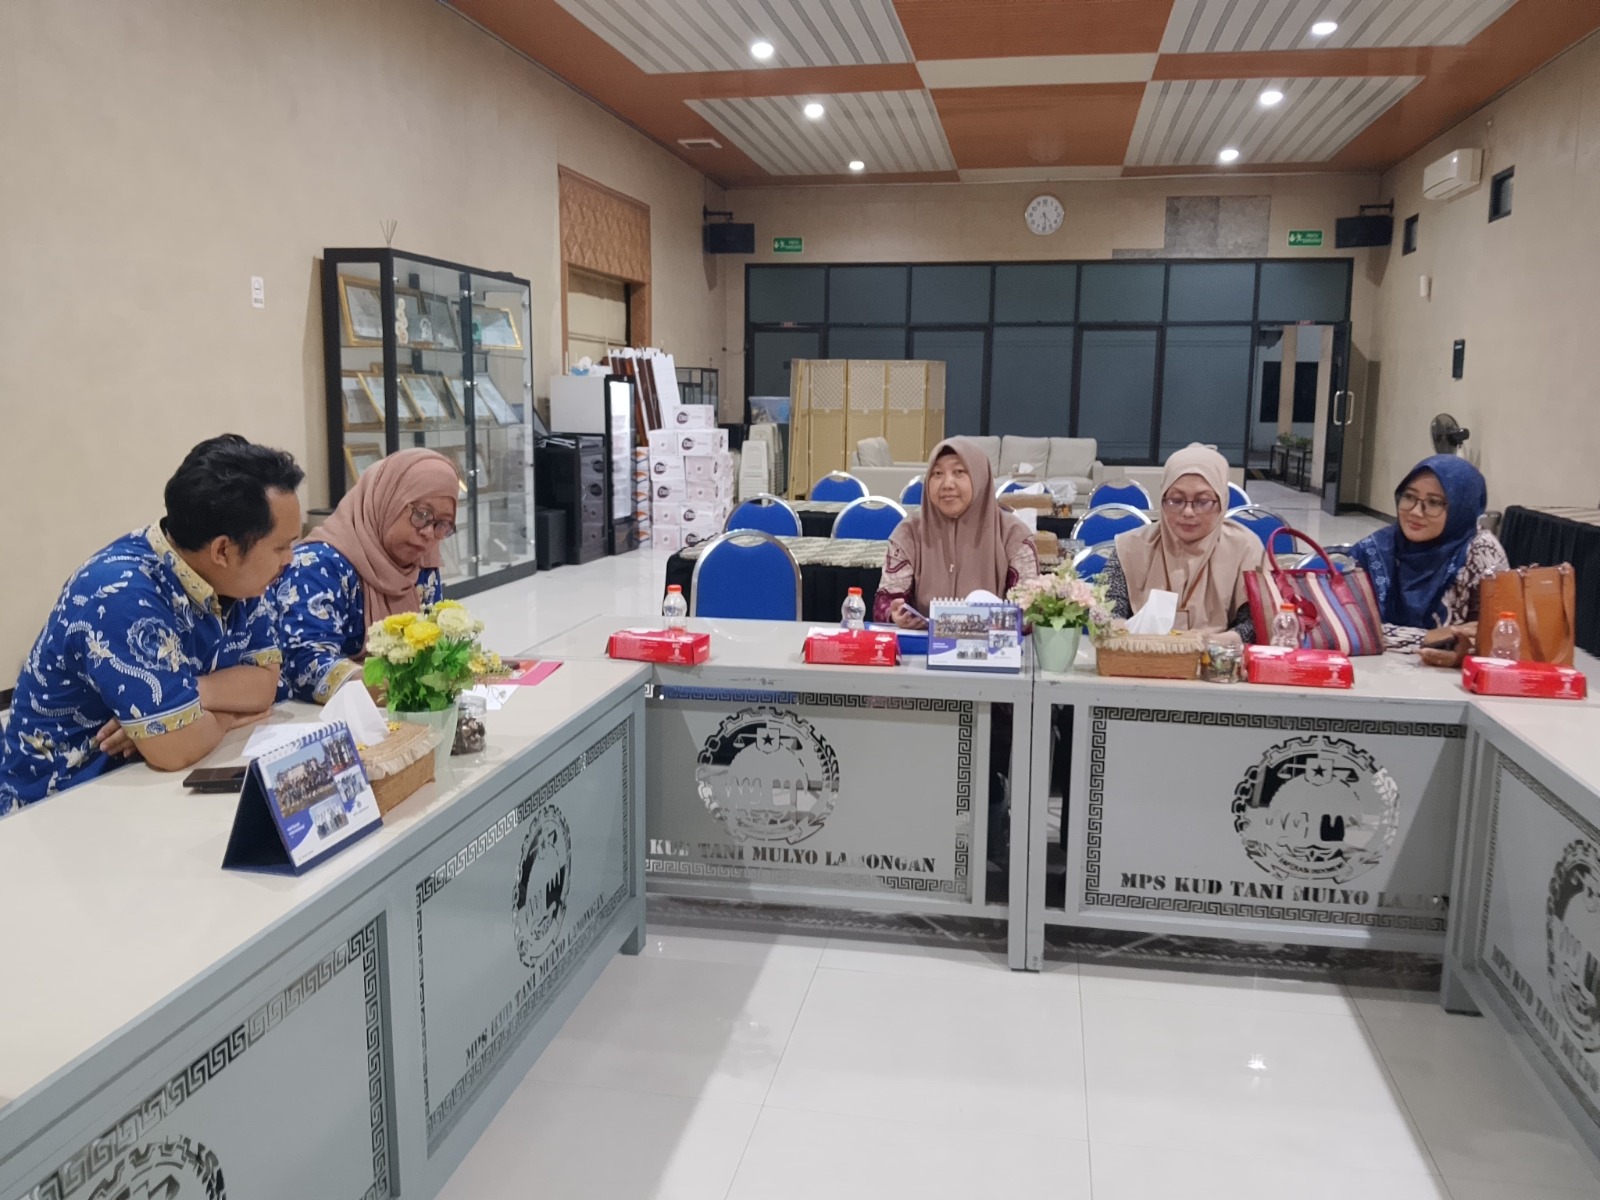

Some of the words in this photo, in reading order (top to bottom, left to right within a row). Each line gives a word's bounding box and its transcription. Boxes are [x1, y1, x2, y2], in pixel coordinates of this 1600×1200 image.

[697, 843, 744, 860] TANI
[752, 846, 818, 866] MULYO
[825, 851, 936, 873] LAONGAN
[1121, 872, 1166, 891] MPS
[1174, 876, 1222, 896] KUD
[1230, 880, 1283, 900] TANI
[1292, 885, 1369, 906] MULYO
[514, 972, 537, 1008] TANI
